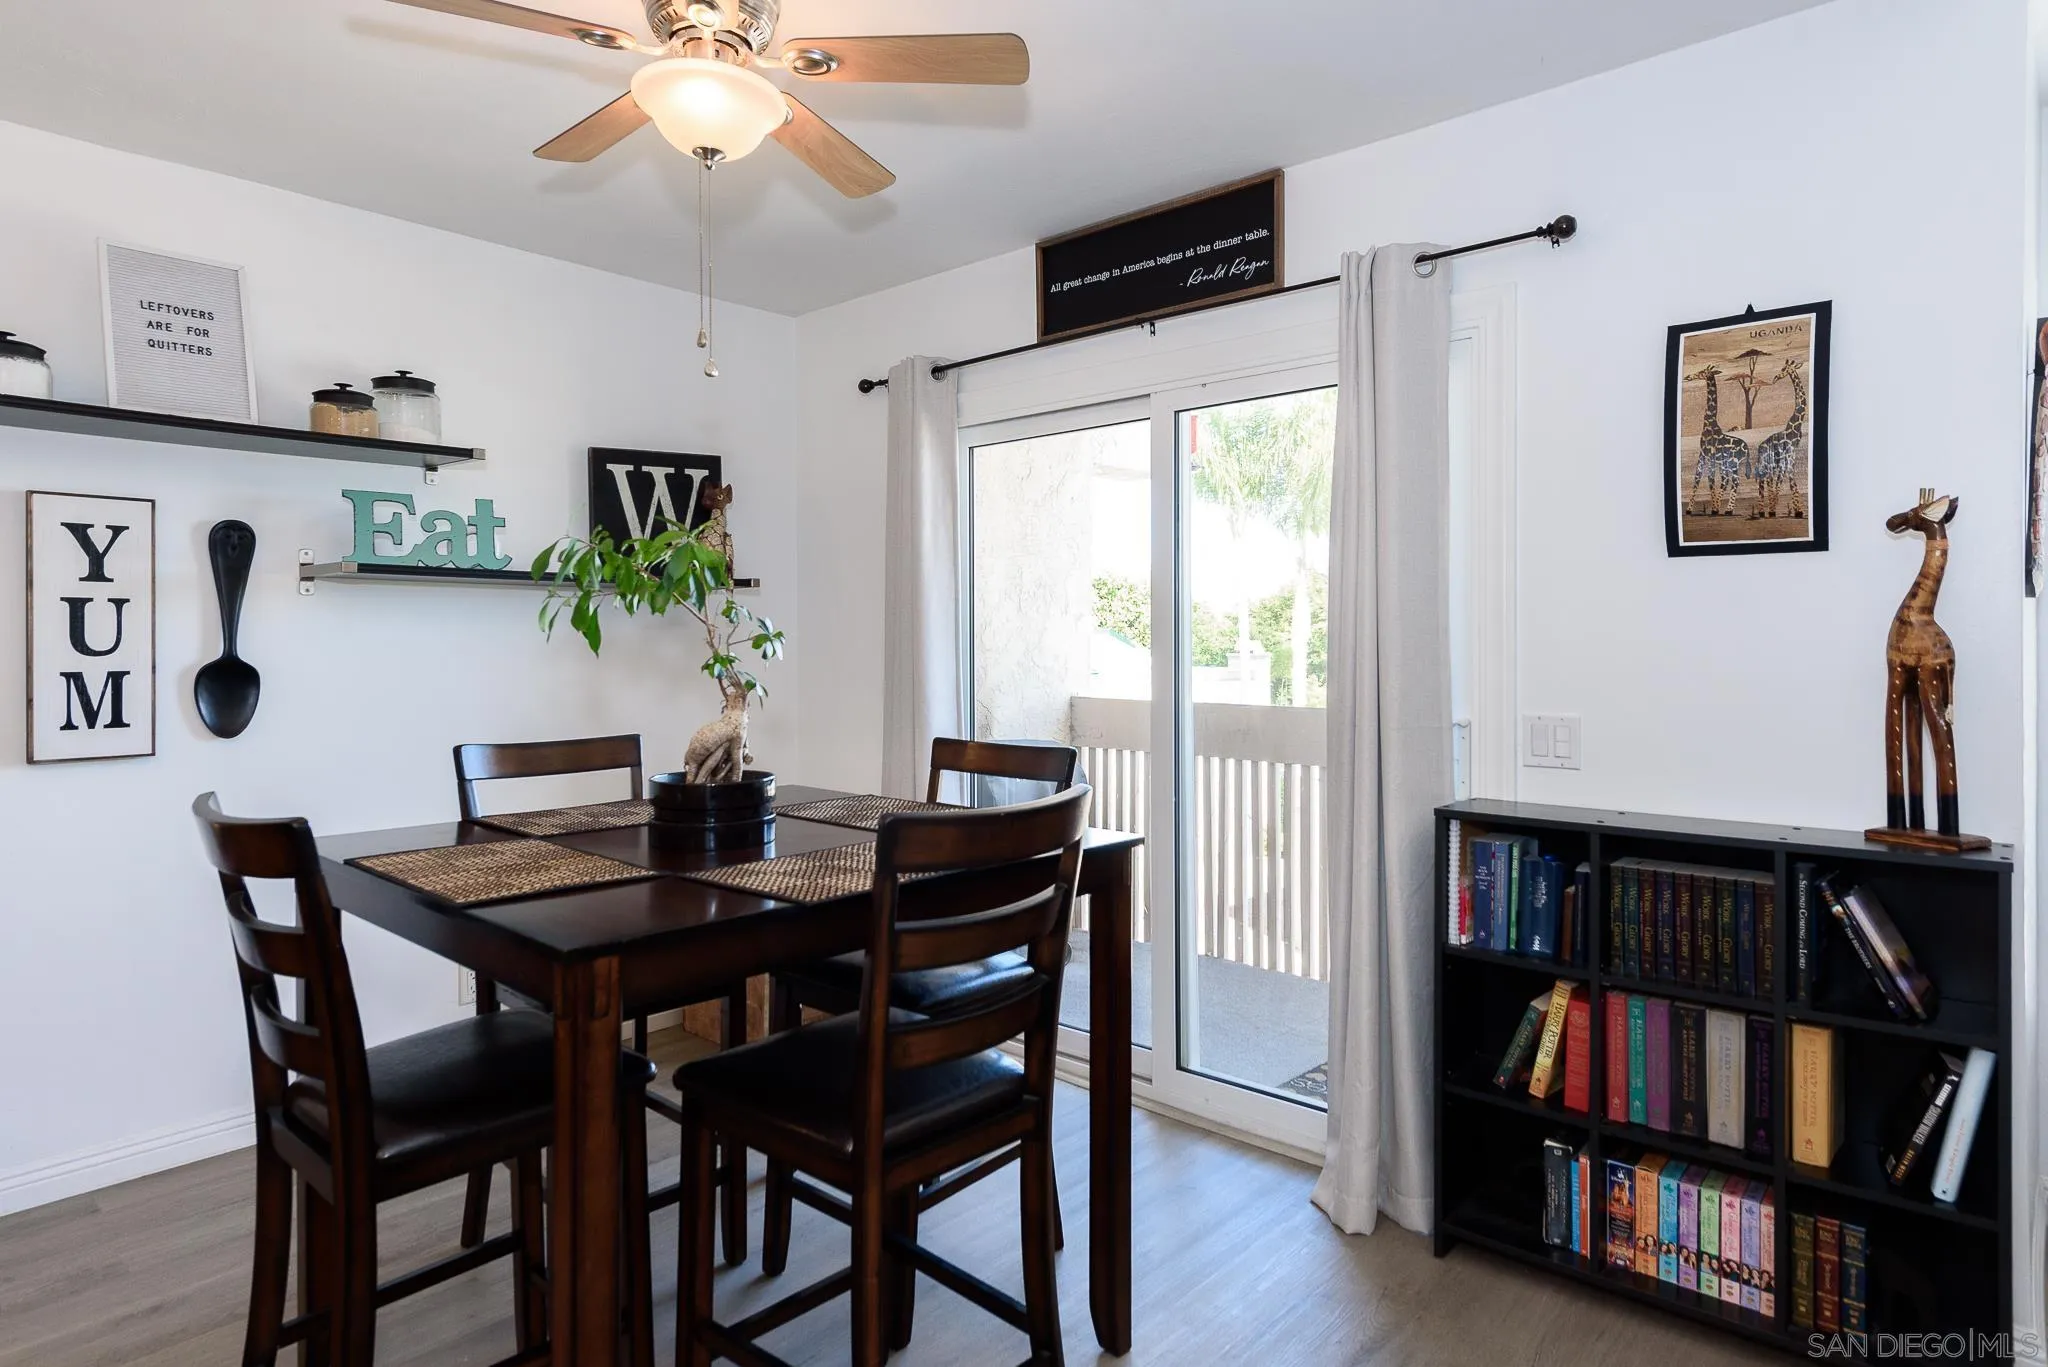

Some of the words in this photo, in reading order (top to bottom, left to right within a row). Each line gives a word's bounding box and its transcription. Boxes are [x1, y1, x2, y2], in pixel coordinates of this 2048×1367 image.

[1050, 284, 1061, 293] All
[1063, 278, 1083, 291] great
[1083, 270, 1110, 284] change
[1112, 268, 1121, 277] in
[1122, 258, 1155, 274] America
[1156, 251, 1183, 266] begins
[1185, 247, 1195, 258] at
[1196, 243, 1211, 254] the
[1213, 234, 1243, 250] dinner
[1245, 227, 1270, 241] table.
[1187, 265, 1225, 288] Ronald
[1229, 256, 1270, 281] Reagan
[140, 300, 214, 321] LEFTOVERS
[147, 320, 173, 332] ARE
[186, 326, 210, 338] FOR
[1750, 325, 1803, 339] UGANDA
[147, 338, 213, 357] QUITTERS
[606, 463, 709, 550] W
[341, 489, 513, 570] Eat
[60, 522, 131, 731] YUM
[1549, 1002, 1565, 1030] HARRY
[1541, 1029, 1558, 1059] POTTER
